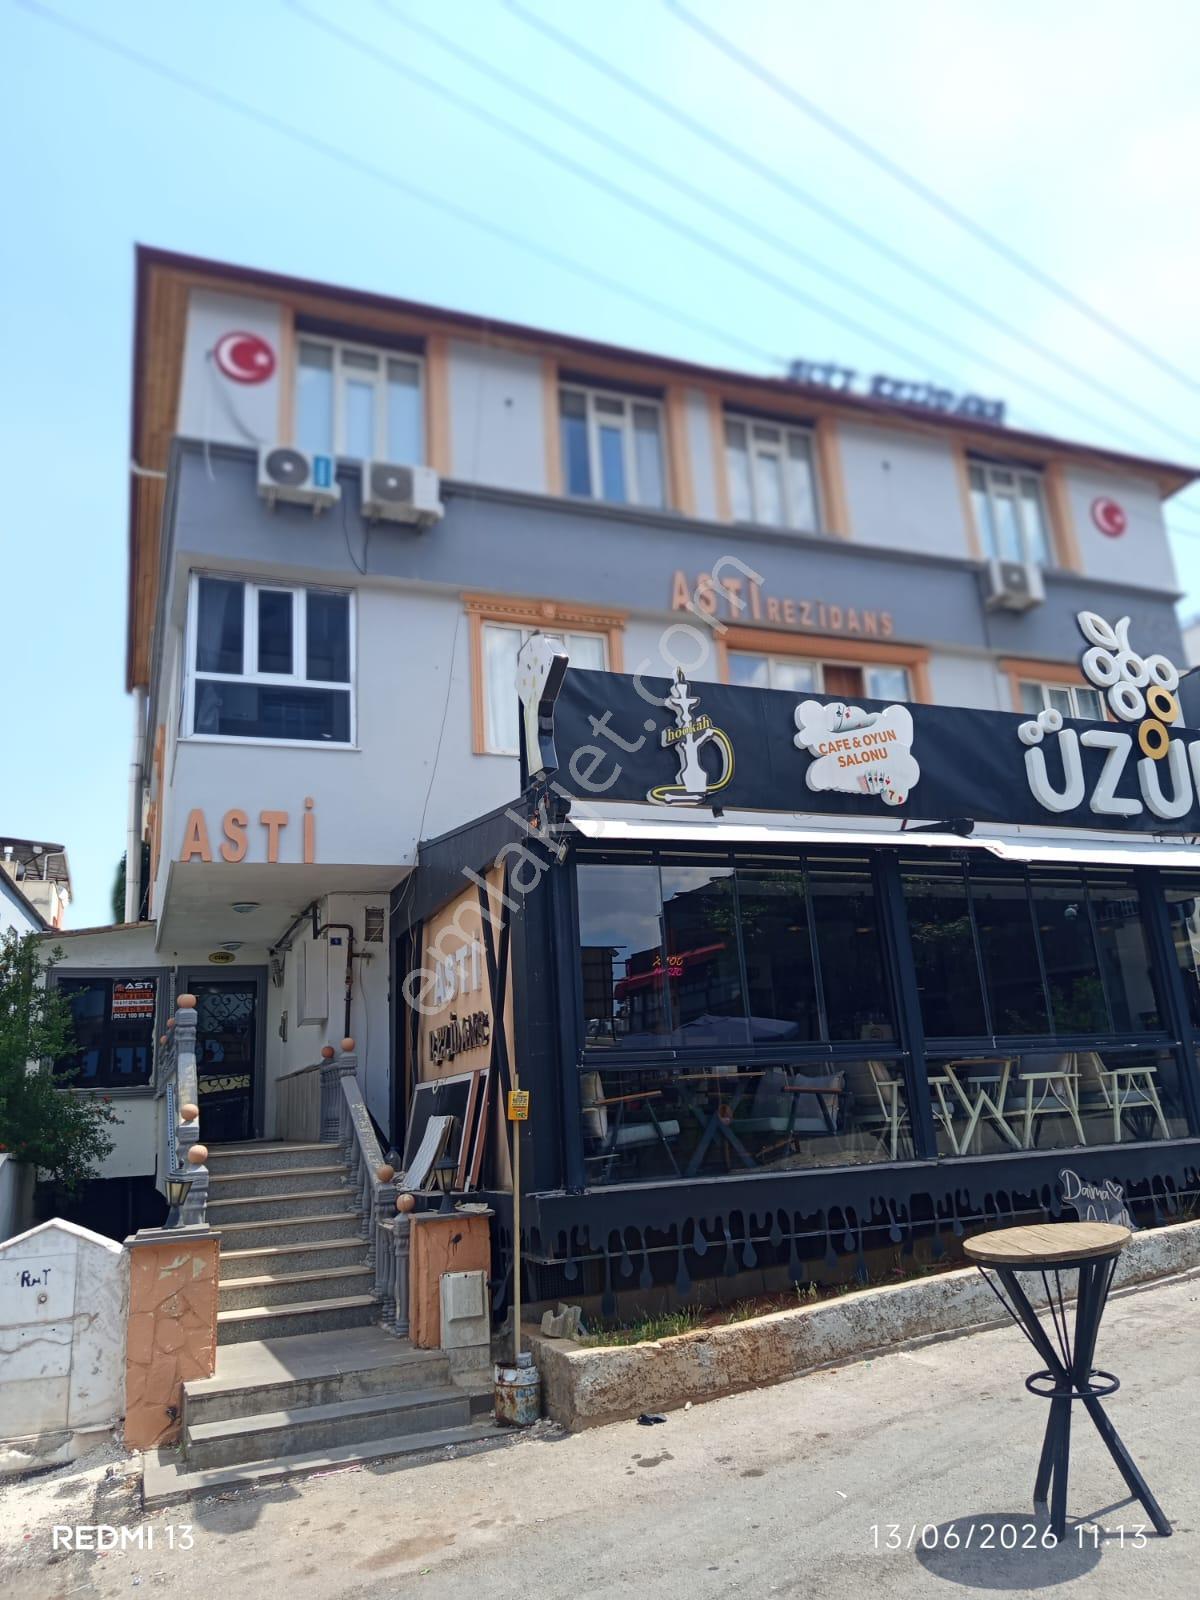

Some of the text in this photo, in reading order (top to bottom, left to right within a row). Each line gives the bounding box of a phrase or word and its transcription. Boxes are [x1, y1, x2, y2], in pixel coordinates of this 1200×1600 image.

[668, 716, 710, 741] hookah
[818, 729, 897, 755] CAFE & OYUN
[837, 747, 888, 768] SALONU
[180, 796, 316, 864] ASTİ
[1061, 1169, 1110, 1200] Daima
